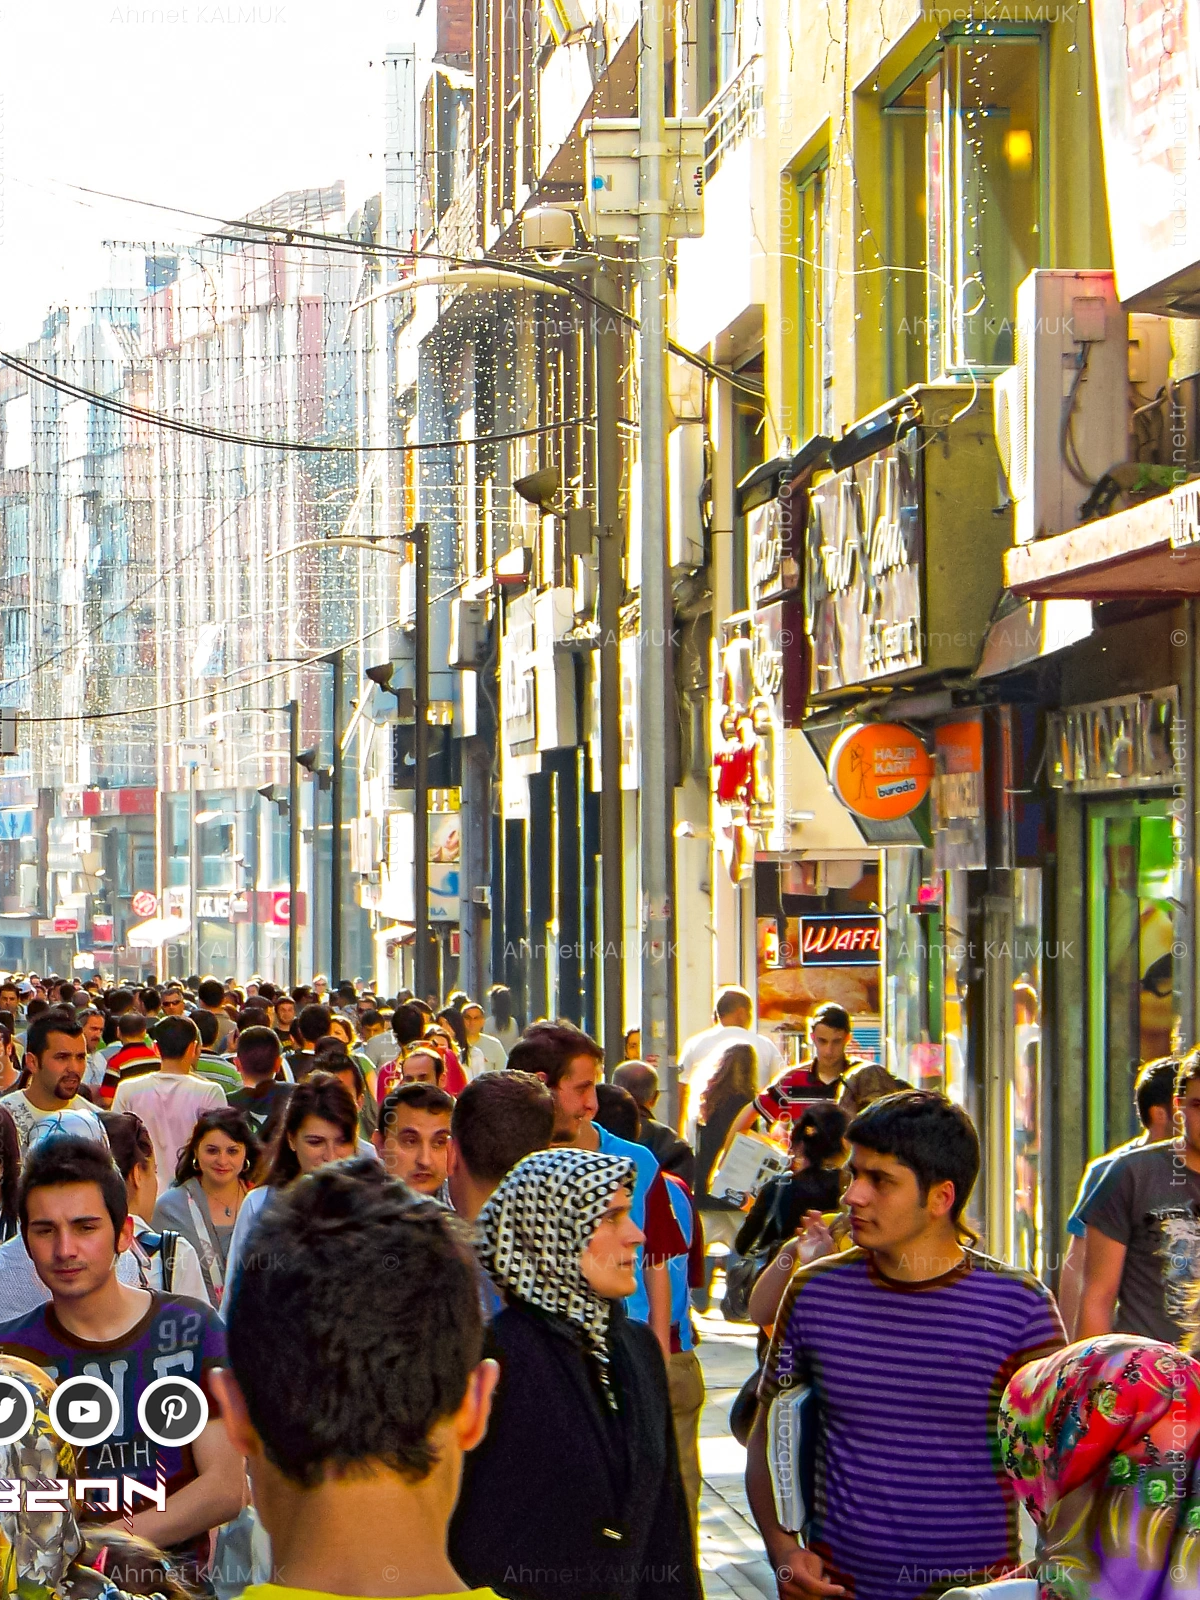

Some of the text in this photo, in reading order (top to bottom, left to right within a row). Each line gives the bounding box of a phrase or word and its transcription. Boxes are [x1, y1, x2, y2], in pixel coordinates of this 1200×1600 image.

[874, 746, 918, 761] HAZIR
[874, 760, 912, 775] KART
[877, 780, 917, 798] burada
[803, 926, 881, 953] WAFFL
[158, 1313, 202, 1352] 92
